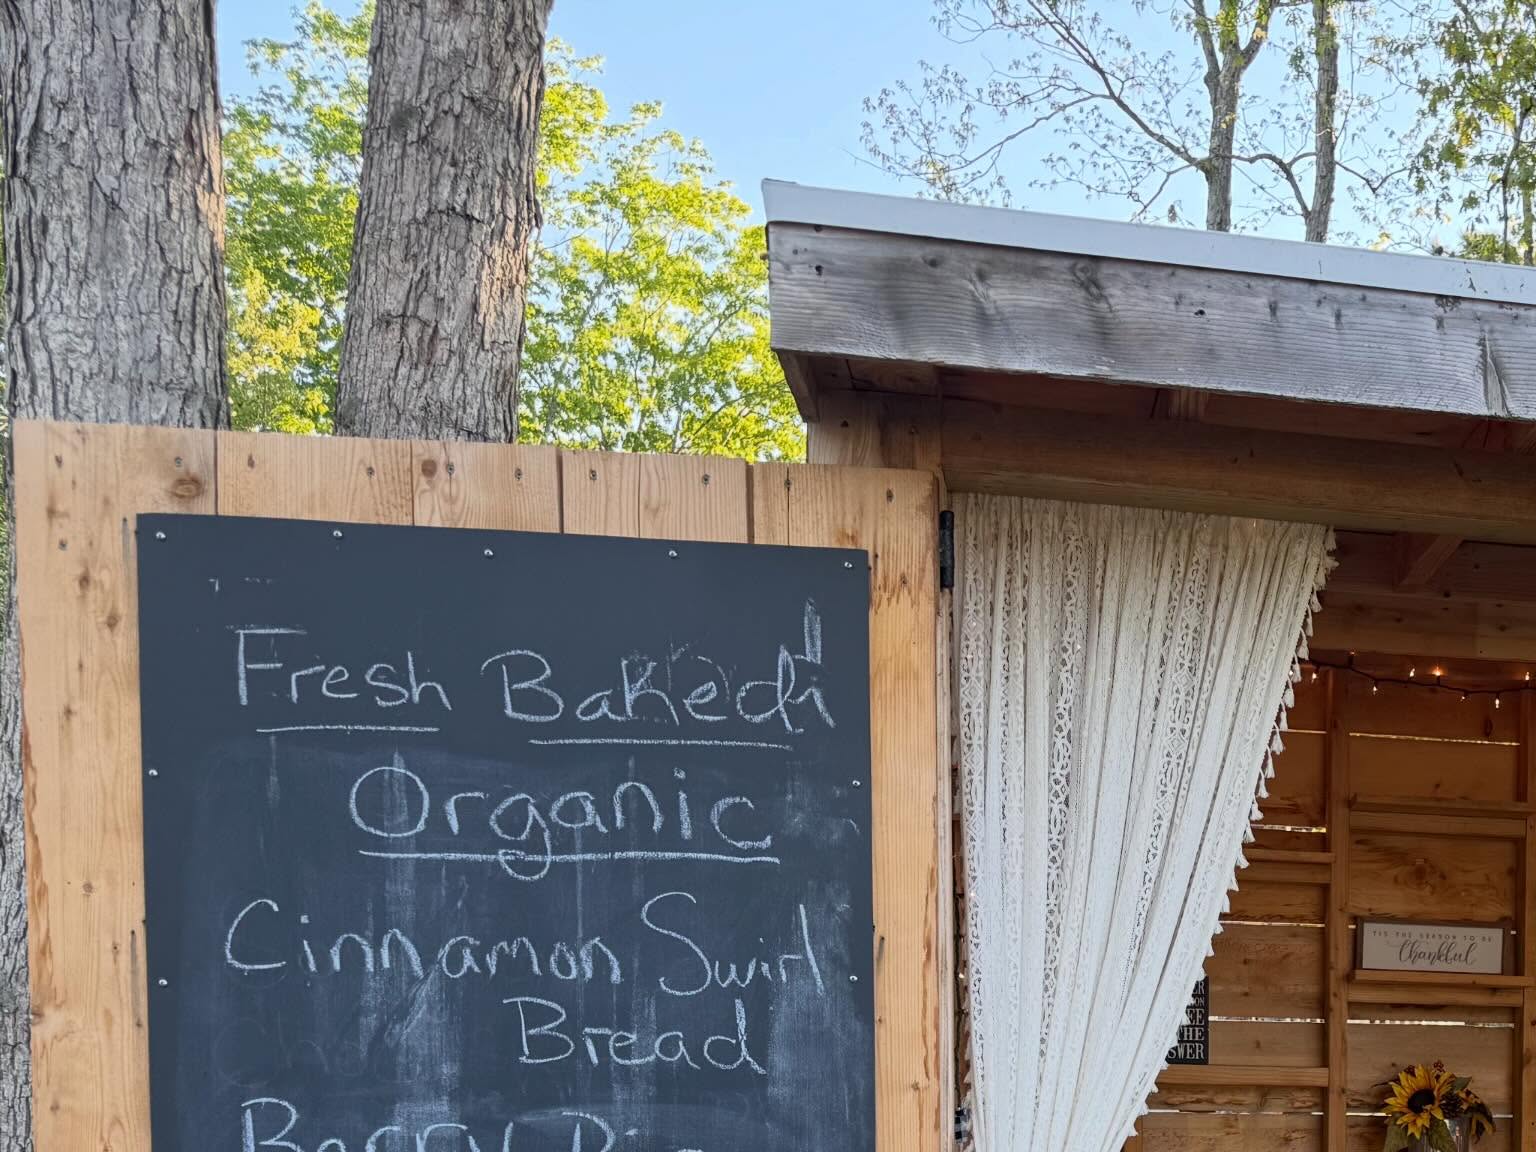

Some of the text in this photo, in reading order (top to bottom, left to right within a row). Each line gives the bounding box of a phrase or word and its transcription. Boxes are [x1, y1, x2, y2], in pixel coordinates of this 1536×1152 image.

[234, 628, 452, 711] Fresh
[349, 766, 774, 881] Organic
[225, 892, 825, 997] Cinnamon Swirl
[503, 996, 766, 1074] Bread
